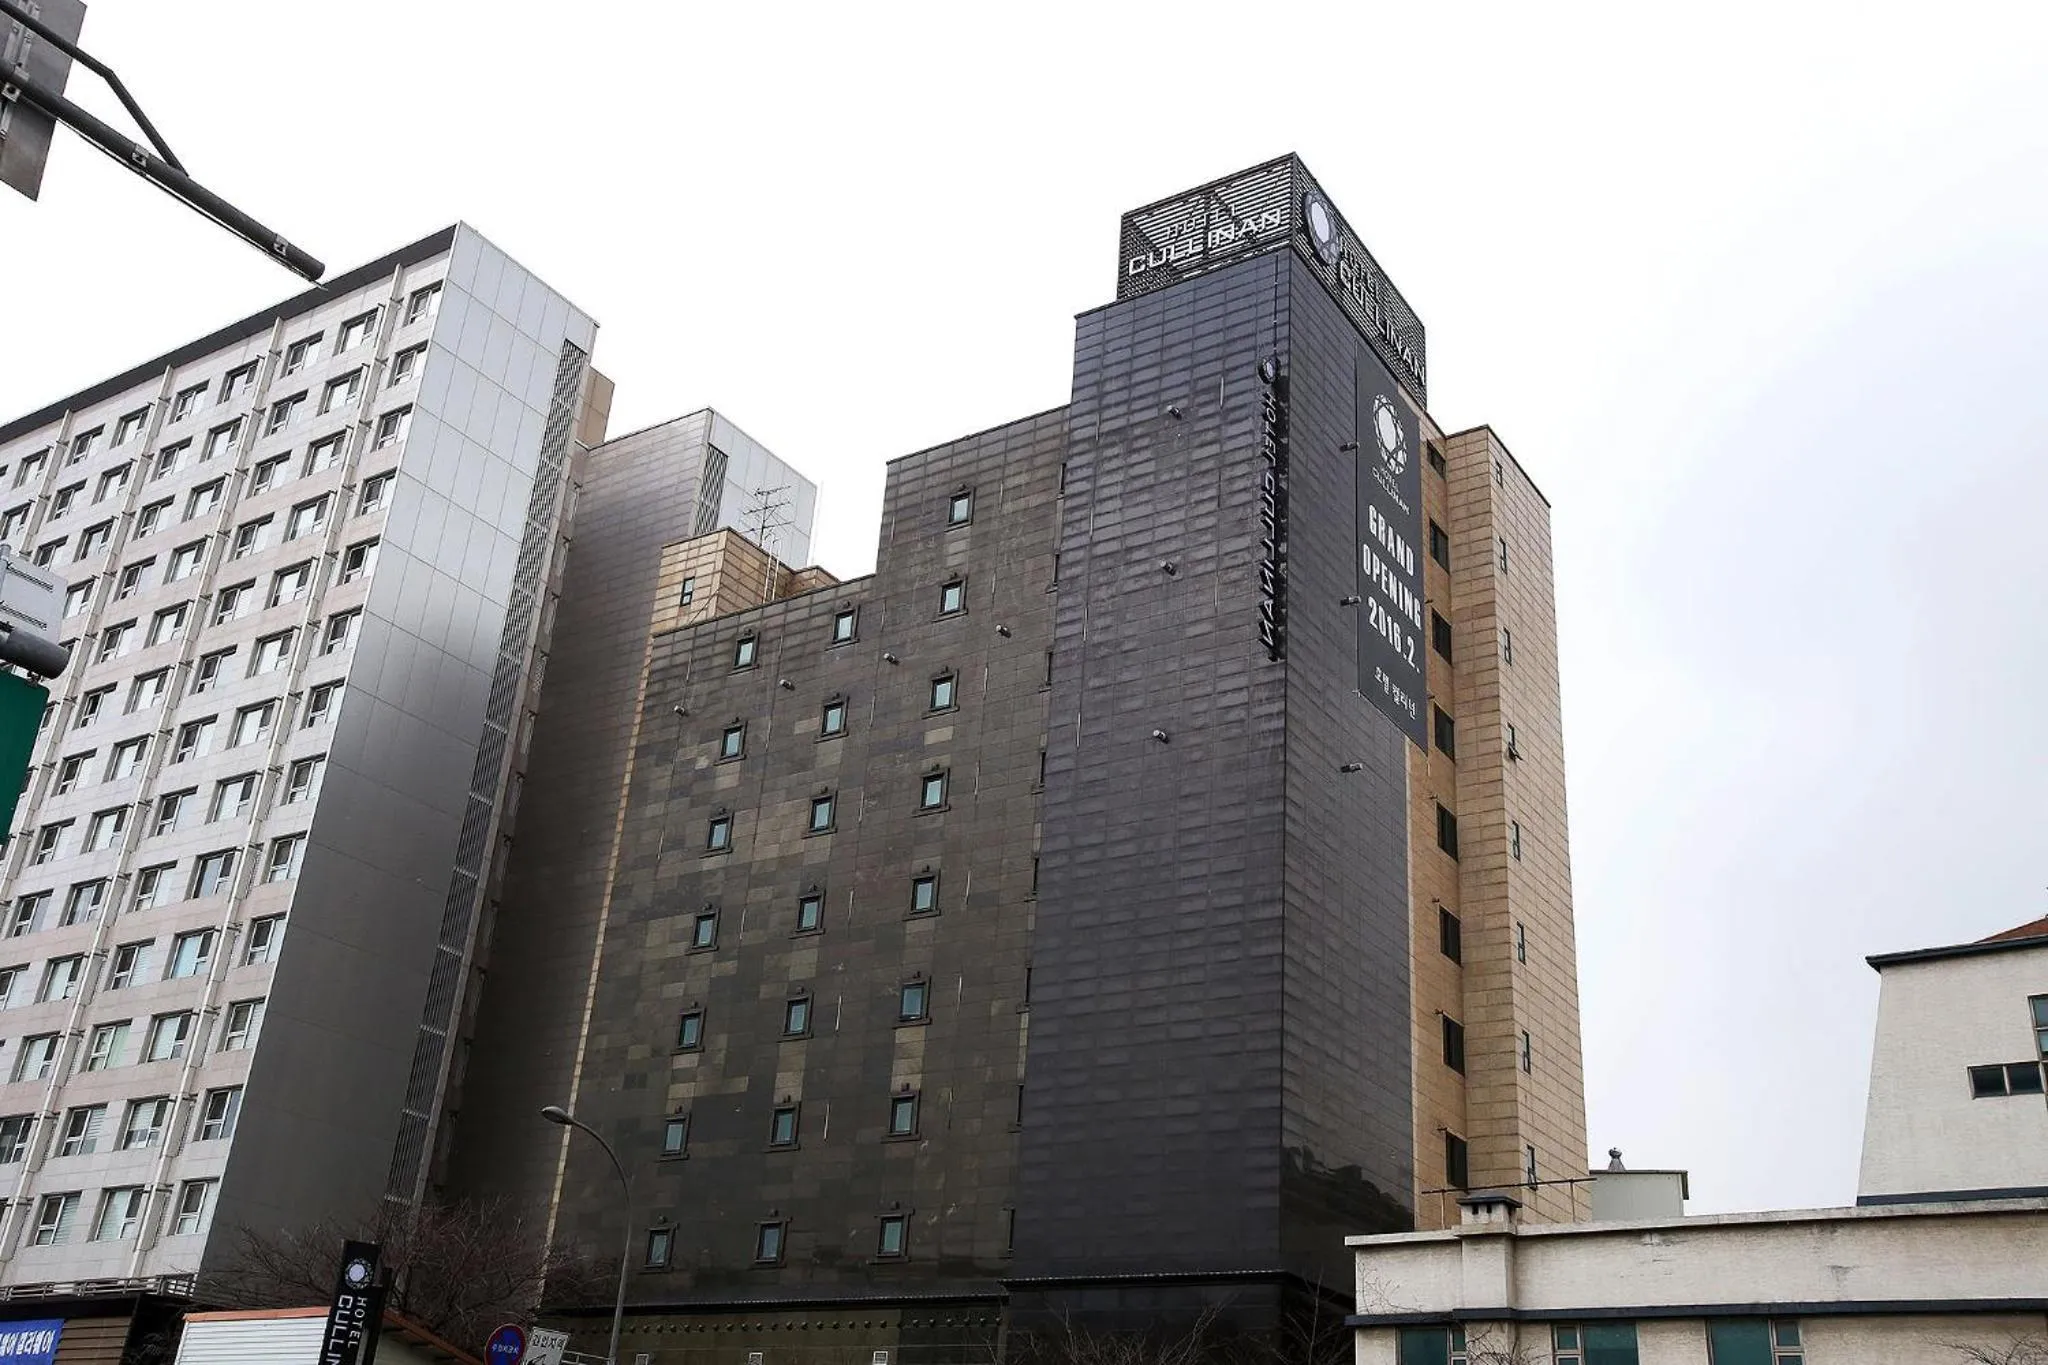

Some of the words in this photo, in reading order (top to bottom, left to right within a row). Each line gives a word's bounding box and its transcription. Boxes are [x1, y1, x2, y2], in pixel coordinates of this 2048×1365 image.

[1128, 208, 1281, 276] CULLINAN
[1165, 203, 1237, 239] HOTEL
[1340, 259, 1426, 386] CULLINAN
[1368, 504, 1414, 577] GRAND
[1363, 543, 1421, 630] OPENING
[1368, 596, 1421, 674] 2016.2.
[1375, 666, 1390, 696] 호텔
[347, 1296, 368, 1349] HOTEL
